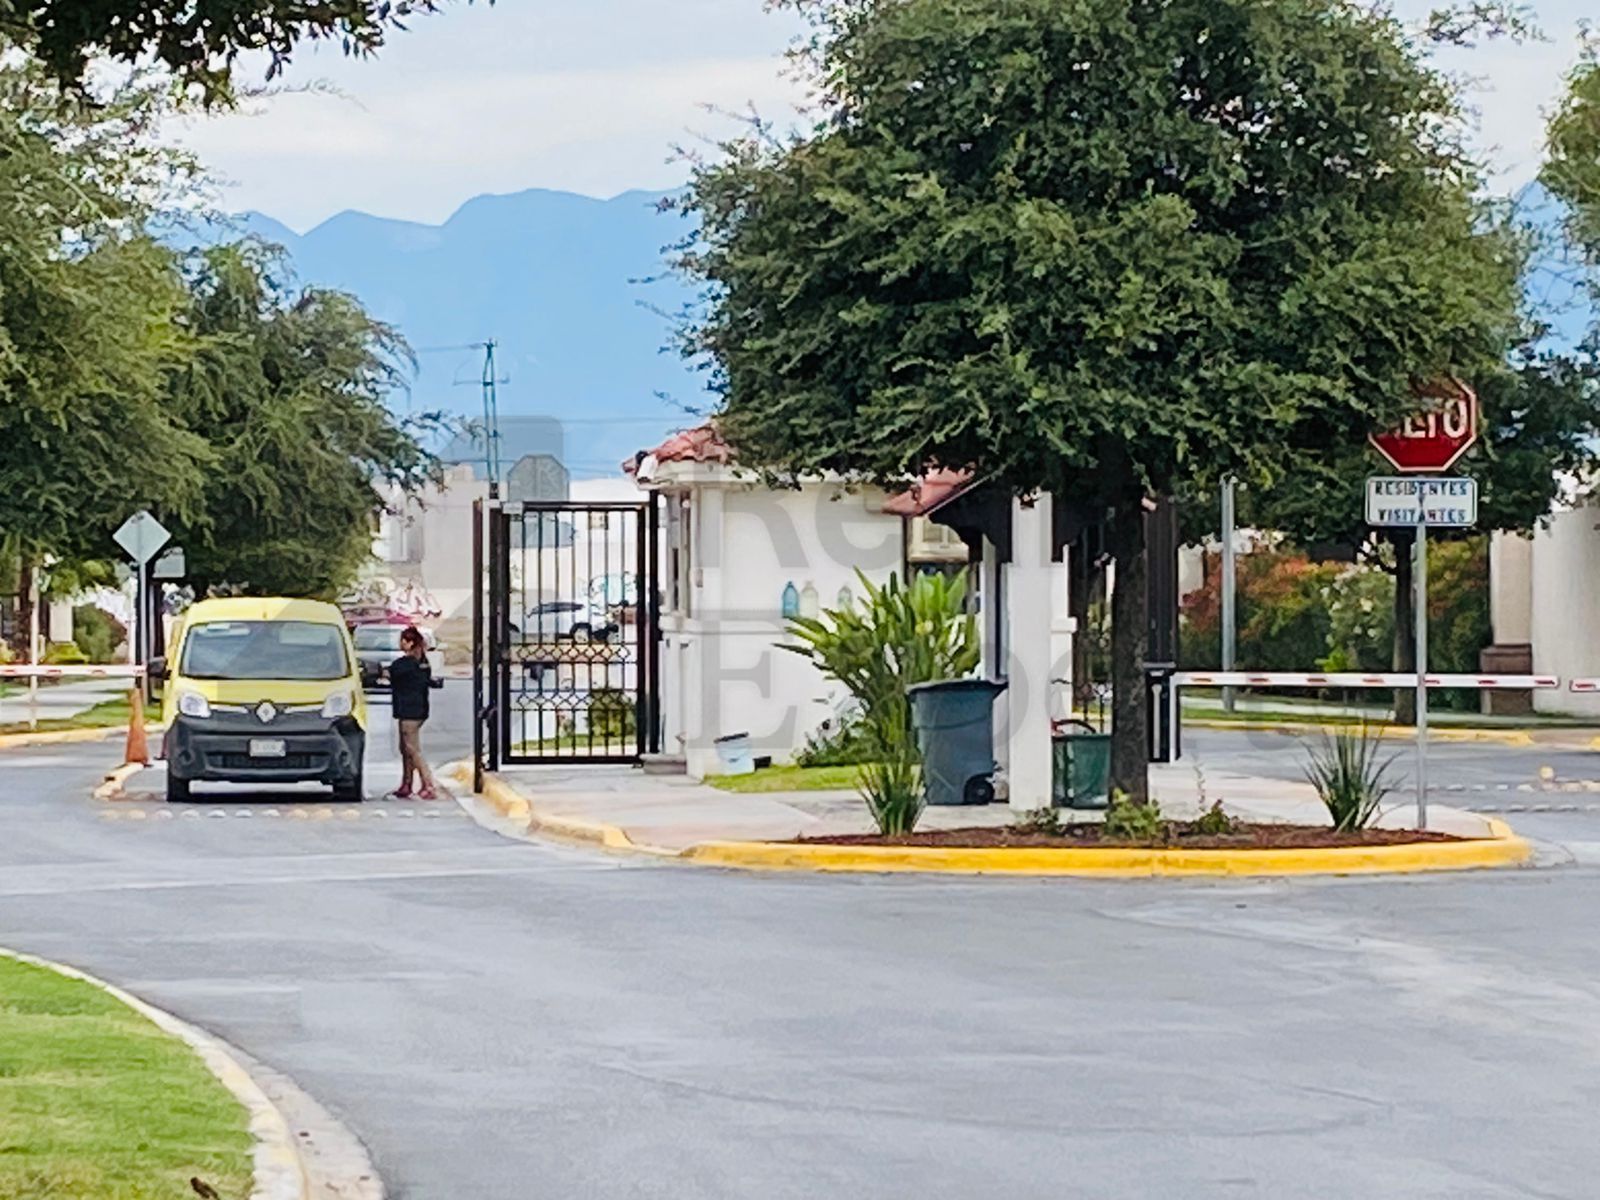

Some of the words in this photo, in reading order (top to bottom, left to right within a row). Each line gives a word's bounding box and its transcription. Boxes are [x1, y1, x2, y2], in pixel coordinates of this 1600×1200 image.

[1379, 398, 1467, 438] LTO
[1375, 481, 1467, 495] RESIDENTES
[1378, 509, 1466, 522] VISITANTES
